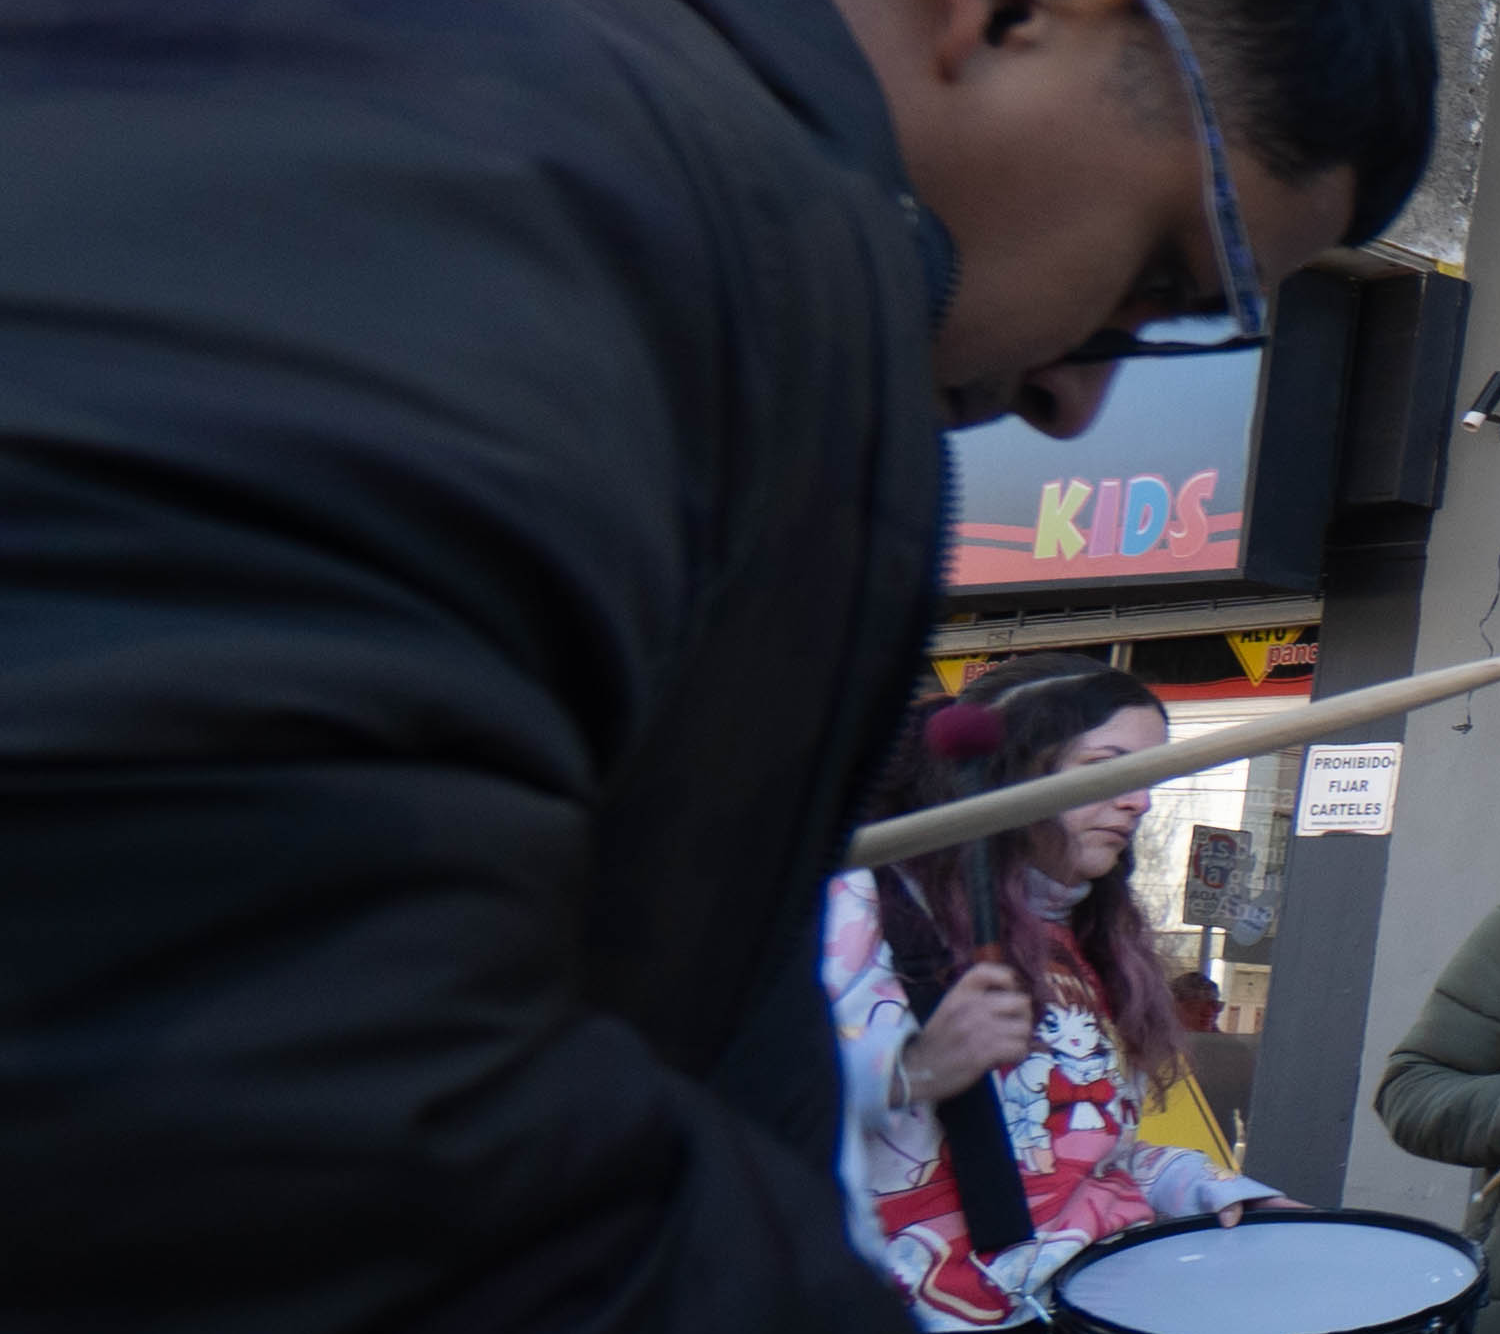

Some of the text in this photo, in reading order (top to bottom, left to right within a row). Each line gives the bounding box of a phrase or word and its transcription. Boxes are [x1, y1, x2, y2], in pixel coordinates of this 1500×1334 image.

[1033, 468, 1218, 560] KIDS
[1314, 756, 1391, 769] PROHIBIDO
[1328, 780, 1369, 792] FIJAR
[1310, 803, 1382, 816] CARTELES
